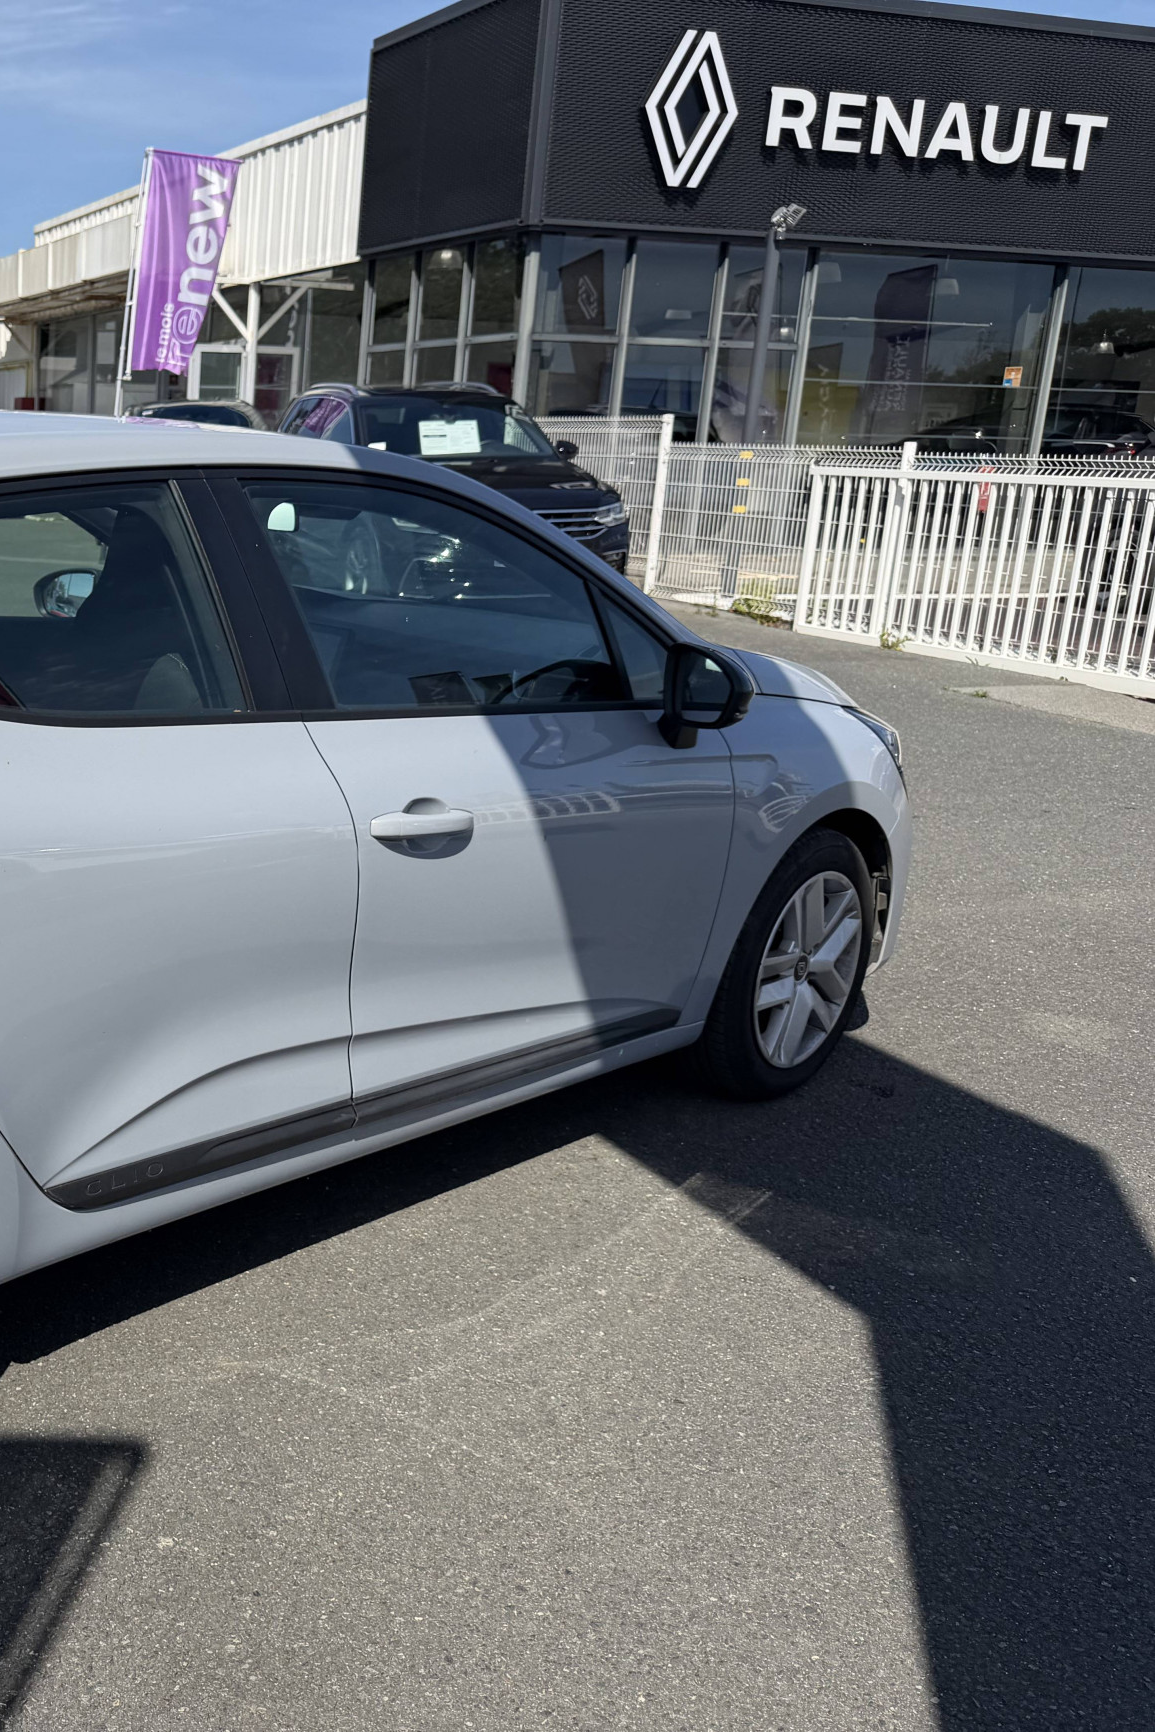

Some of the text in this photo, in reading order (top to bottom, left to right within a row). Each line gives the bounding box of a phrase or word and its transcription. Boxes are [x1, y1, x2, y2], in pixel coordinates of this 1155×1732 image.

[765, 86, 1108, 171] RENAULT
[165, 162, 229, 367] renew
[87, 1161, 164, 1196] CLIO
